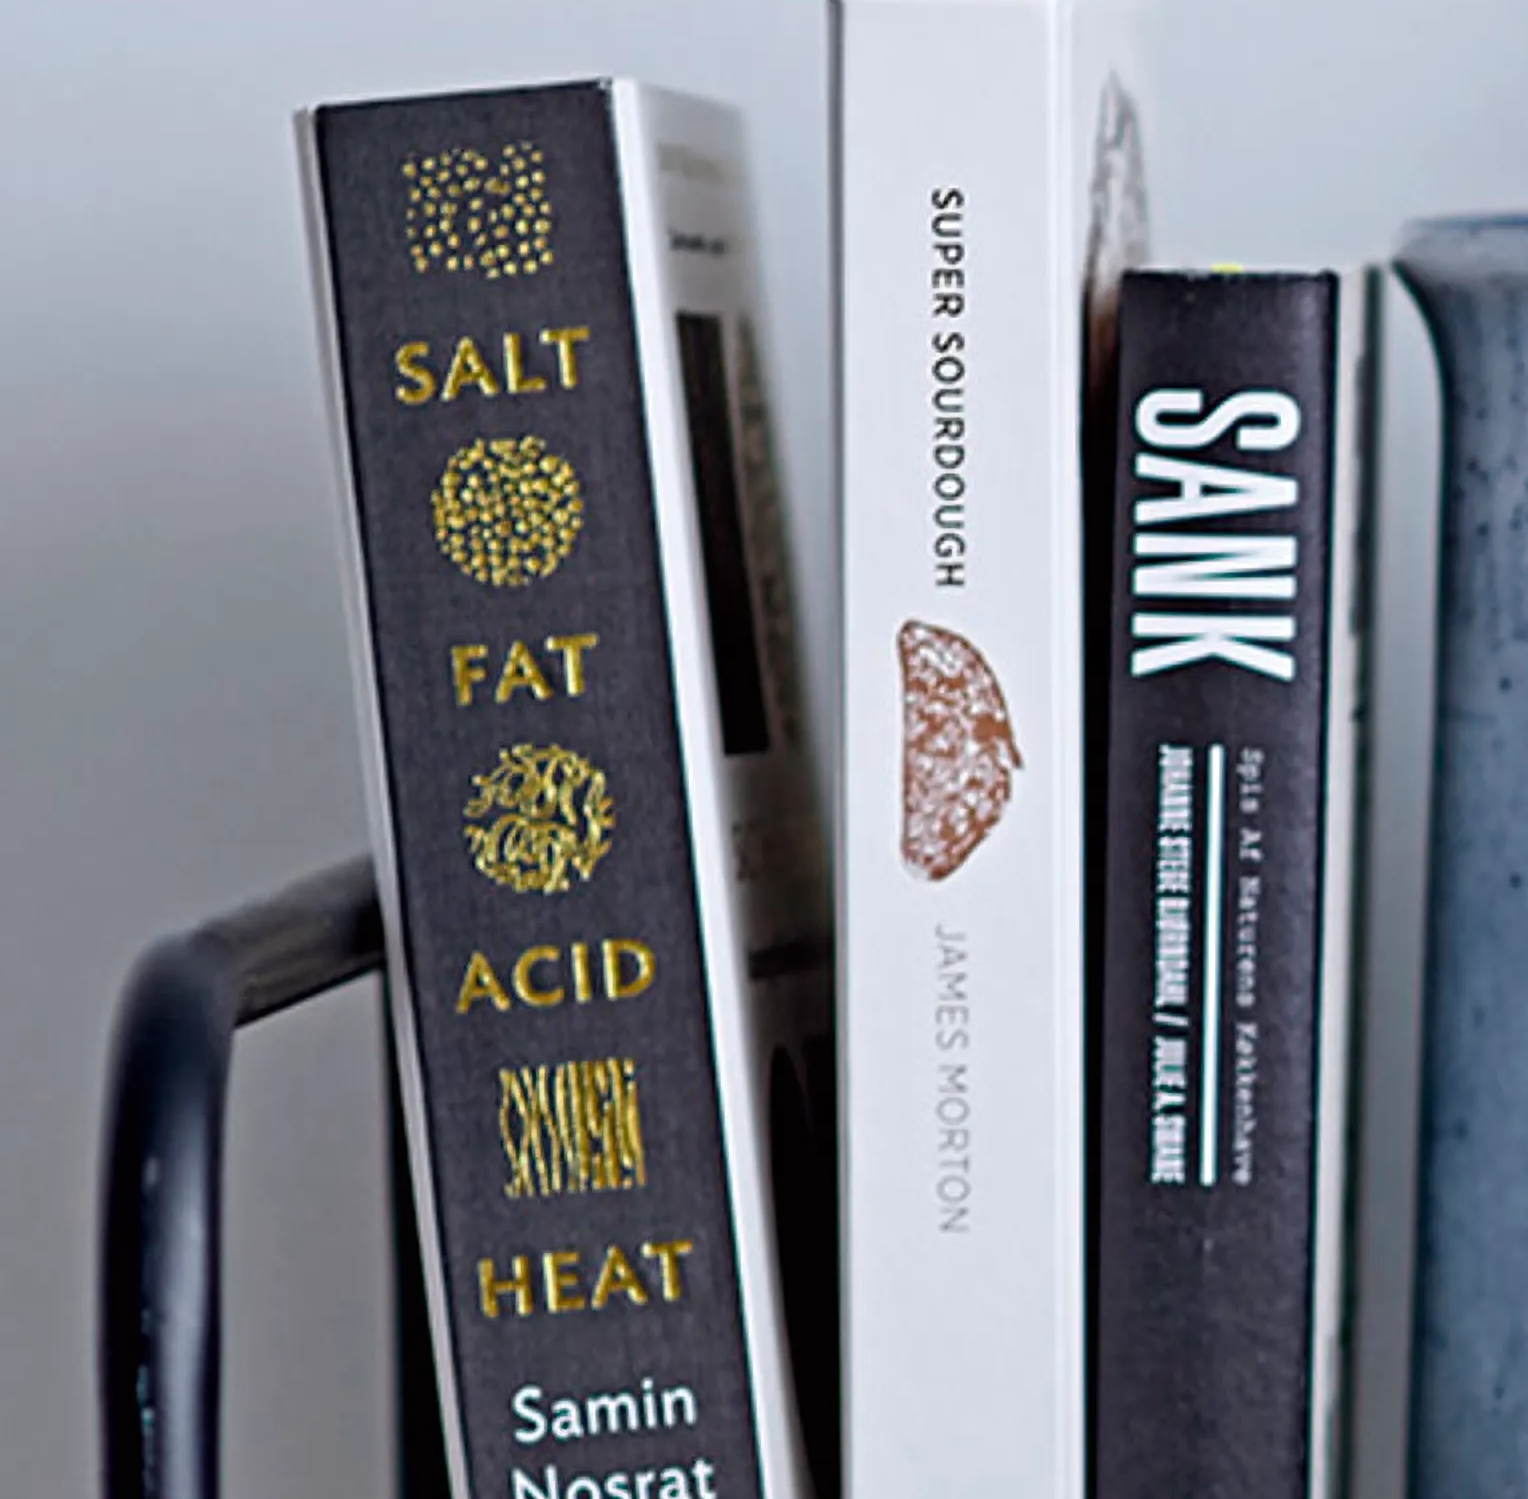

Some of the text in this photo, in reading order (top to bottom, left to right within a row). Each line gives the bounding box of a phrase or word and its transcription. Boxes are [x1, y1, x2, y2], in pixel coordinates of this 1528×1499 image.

[395, 326, 590, 405] SALT
[932, 187, 966, 589] SUPER SOURDOUGH
[1131, 388, 1301, 681] SANK
[451, 634, 598, 704] FAT
[453, 938, 658, 1014] ACID
[935, 922, 971, 1235] JAMES MORTON
[478, 1239, 694, 1318] HEAT
[512, 1377, 698, 1443] Samin
